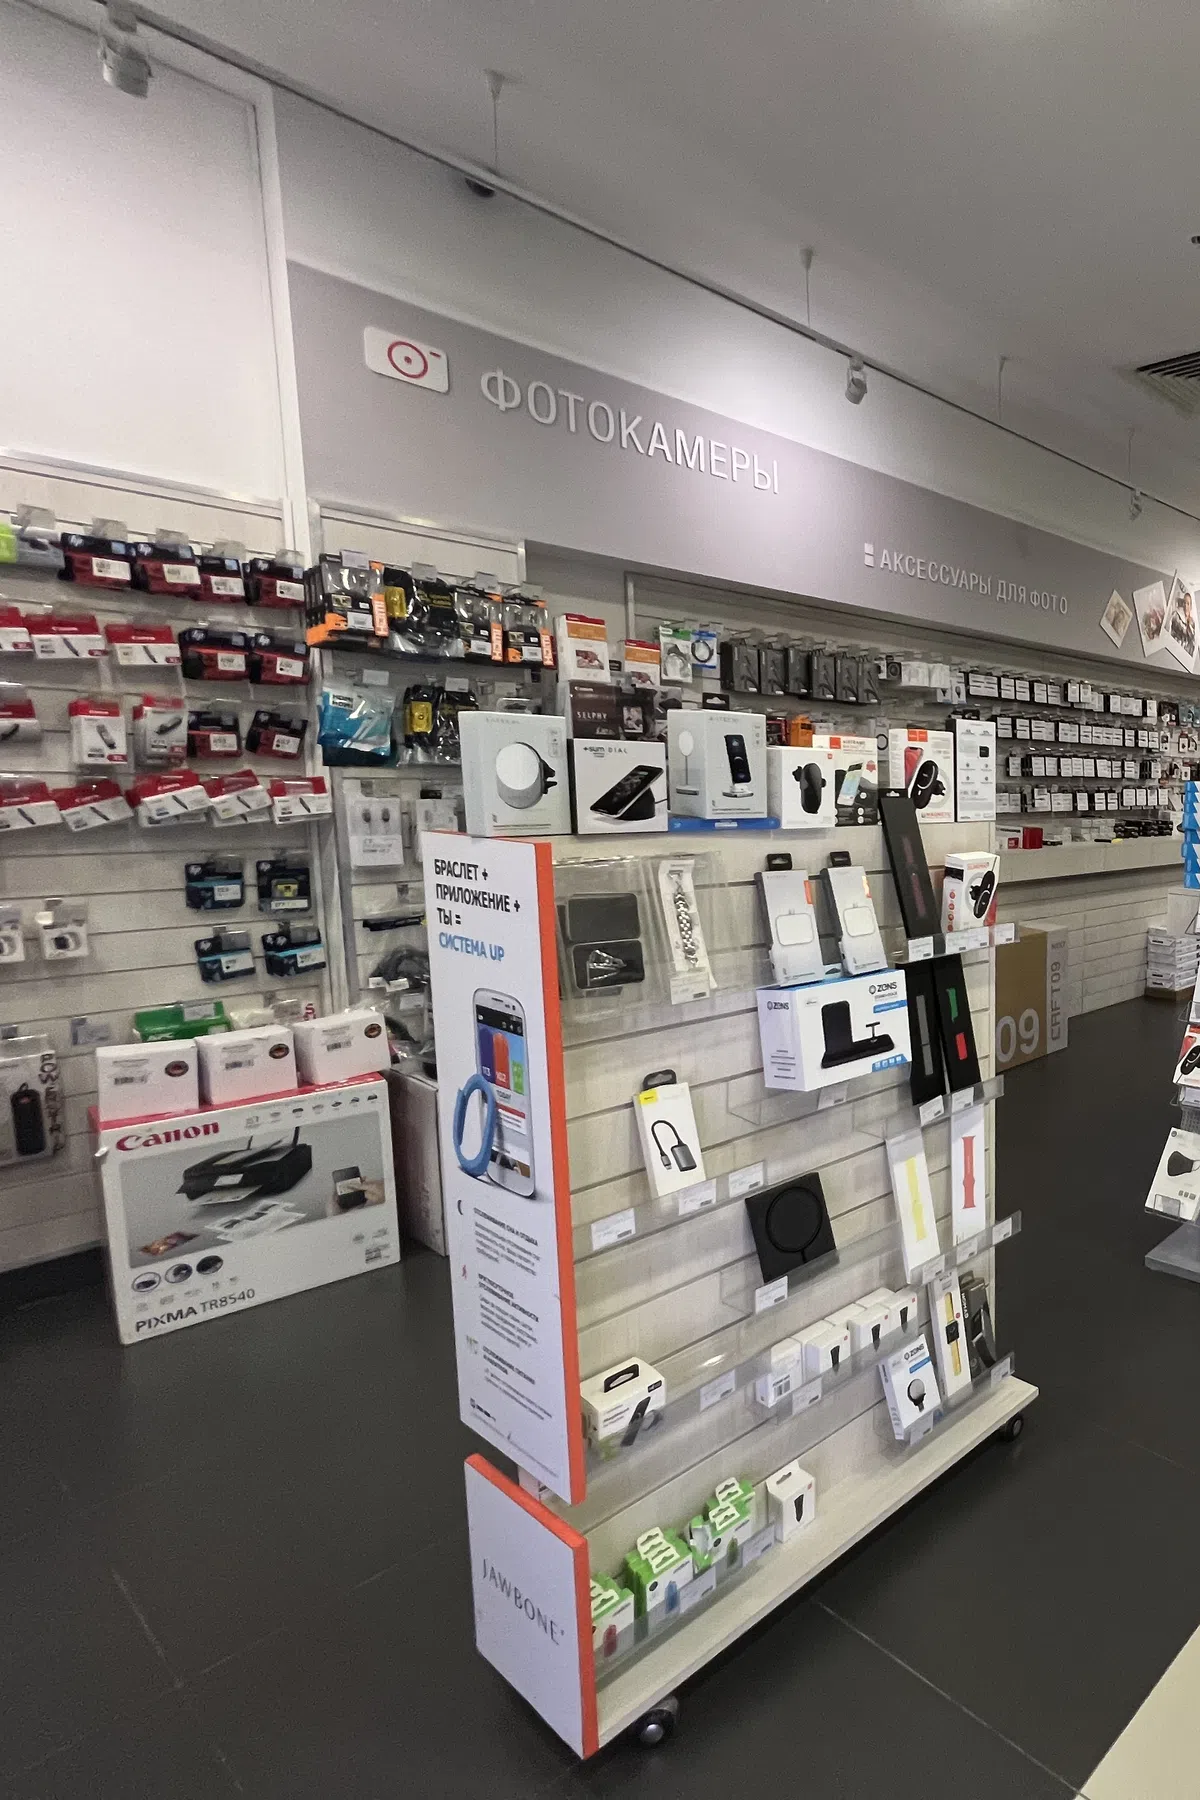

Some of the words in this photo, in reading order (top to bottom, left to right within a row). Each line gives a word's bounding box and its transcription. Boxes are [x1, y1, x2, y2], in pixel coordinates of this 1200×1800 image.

[480, 367, 780, 495] ФОТОКАМЕРЫ
[880, 549, 991, 596] АКСЕССУАРЫ
[996, 580, 1026, 604] ДЛЯ
[1030, 590, 1068, 614] ФОТО
[576, 711, 608, 720] SELPHY
[434, 859, 479, 880] БРАСЛЕТ
[435, 883, 510, 912] ПРИЛОЖЕНИЕ
[437, 907, 452, 926] ТЫ
[439, 932, 487, 958] СИСТЕМА
[489, 944, 505, 961] UP
[995, 1008, 1040, 1063] 09
[116, 1122, 220, 1151] Canon
[135, 1307, 198, 1333] PIXMA
[200, 1288, 256, 1313] TR8540
[961, 1293, 969, 1319] NOMAD
[482, 1558, 562, 1646] JAWBONE
